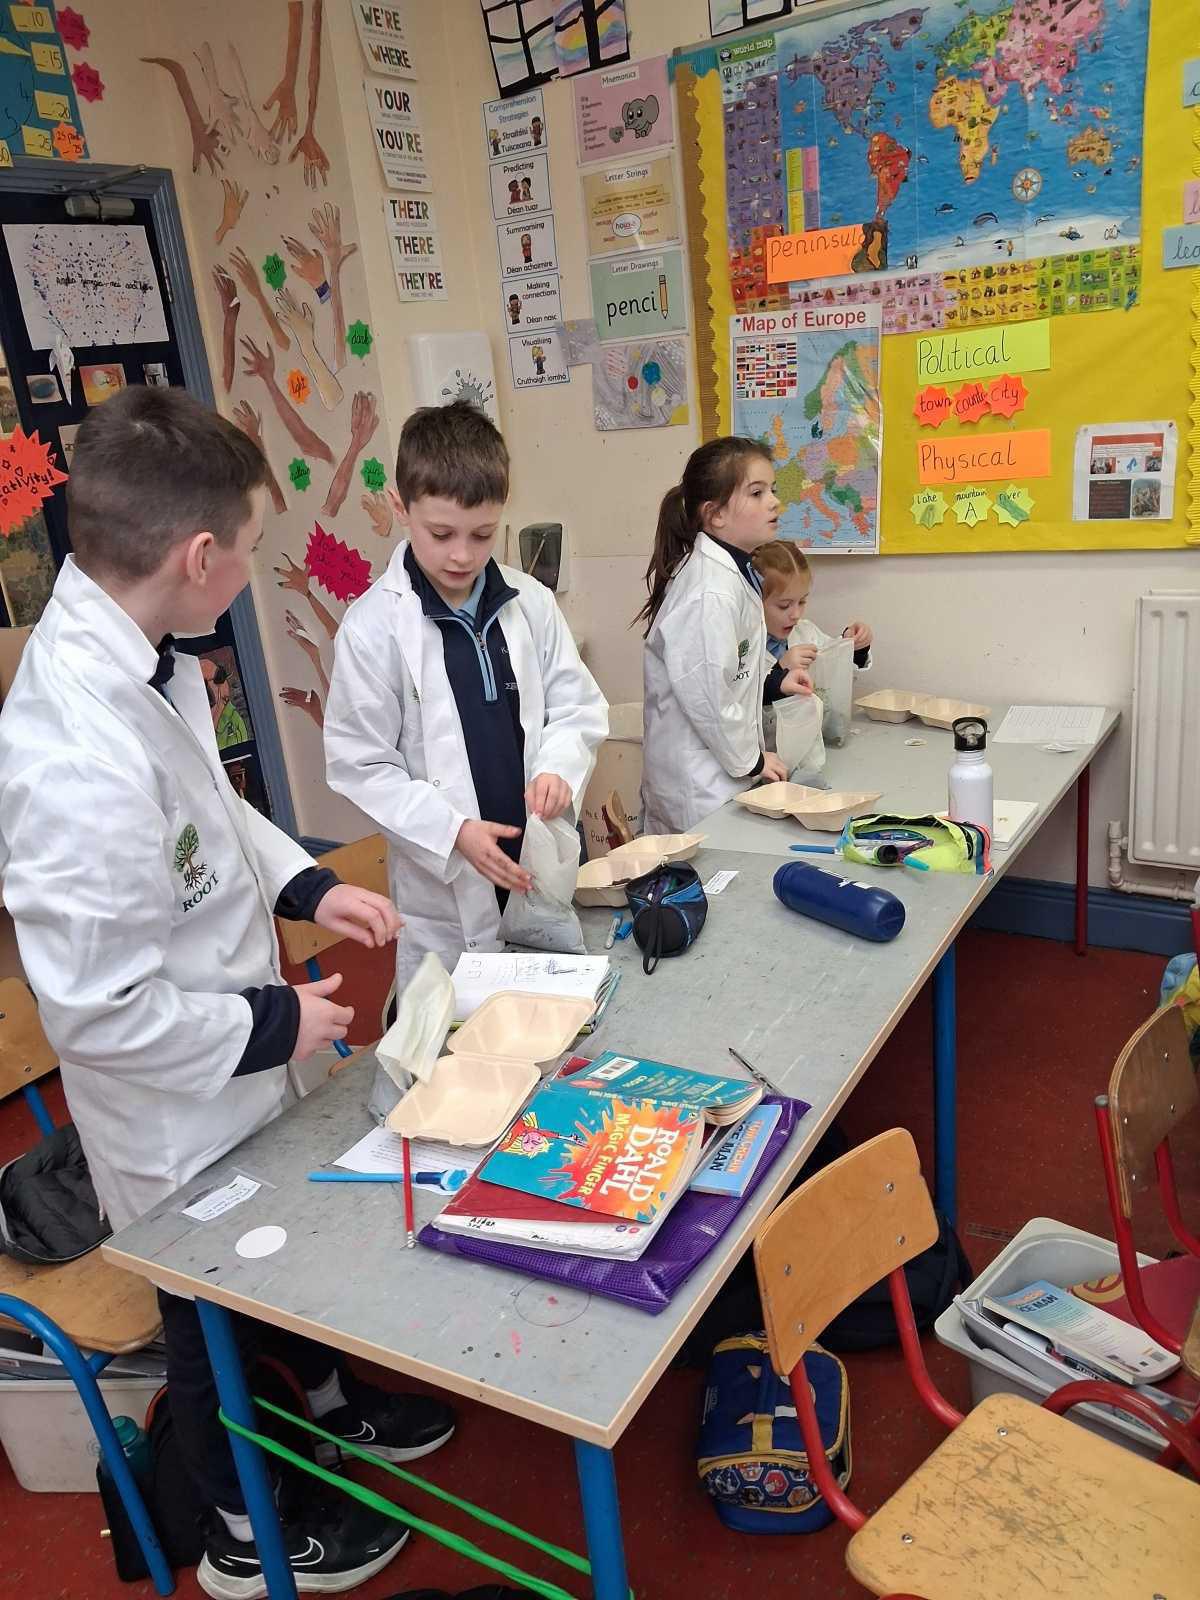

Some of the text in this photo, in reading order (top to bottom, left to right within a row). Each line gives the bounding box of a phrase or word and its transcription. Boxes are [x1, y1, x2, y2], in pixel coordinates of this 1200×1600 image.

[360, 4, 402, 31] WE'RE
[368, 42, 412, 69] WHERE
[756, 38, 774, 50] map
[375, 87, 411, 112] YOUR
[376, 128, 423, 153] YOU'RE
[503, 161, 534, 174] Predicting
[626, 167, 649, 179] Strings
[390, 200, 429, 220] THEIR
[394, 236, 435, 255] THERE
[398, 272, 443, 290] THEY'RE
[742, 310, 867, 333] Map of Europe
[919, 330, 1011, 376] Political
[920, 395, 952, 413] town
[921, 440, 1017, 480] Physical
[0, 468, 55, 498] ativity!
[182, 871, 219, 912] ROOT
[603, 1113, 631, 1152] MAGIC
[600, 1124, 659, 1196] DAHL
[628, 1127, 681, 1202] ROALD
[709, 1141, 735, 1172] MAN
[579, 1154, 613, 1196] FINGER
[1036, 1294, 1059, 1310] MAN
